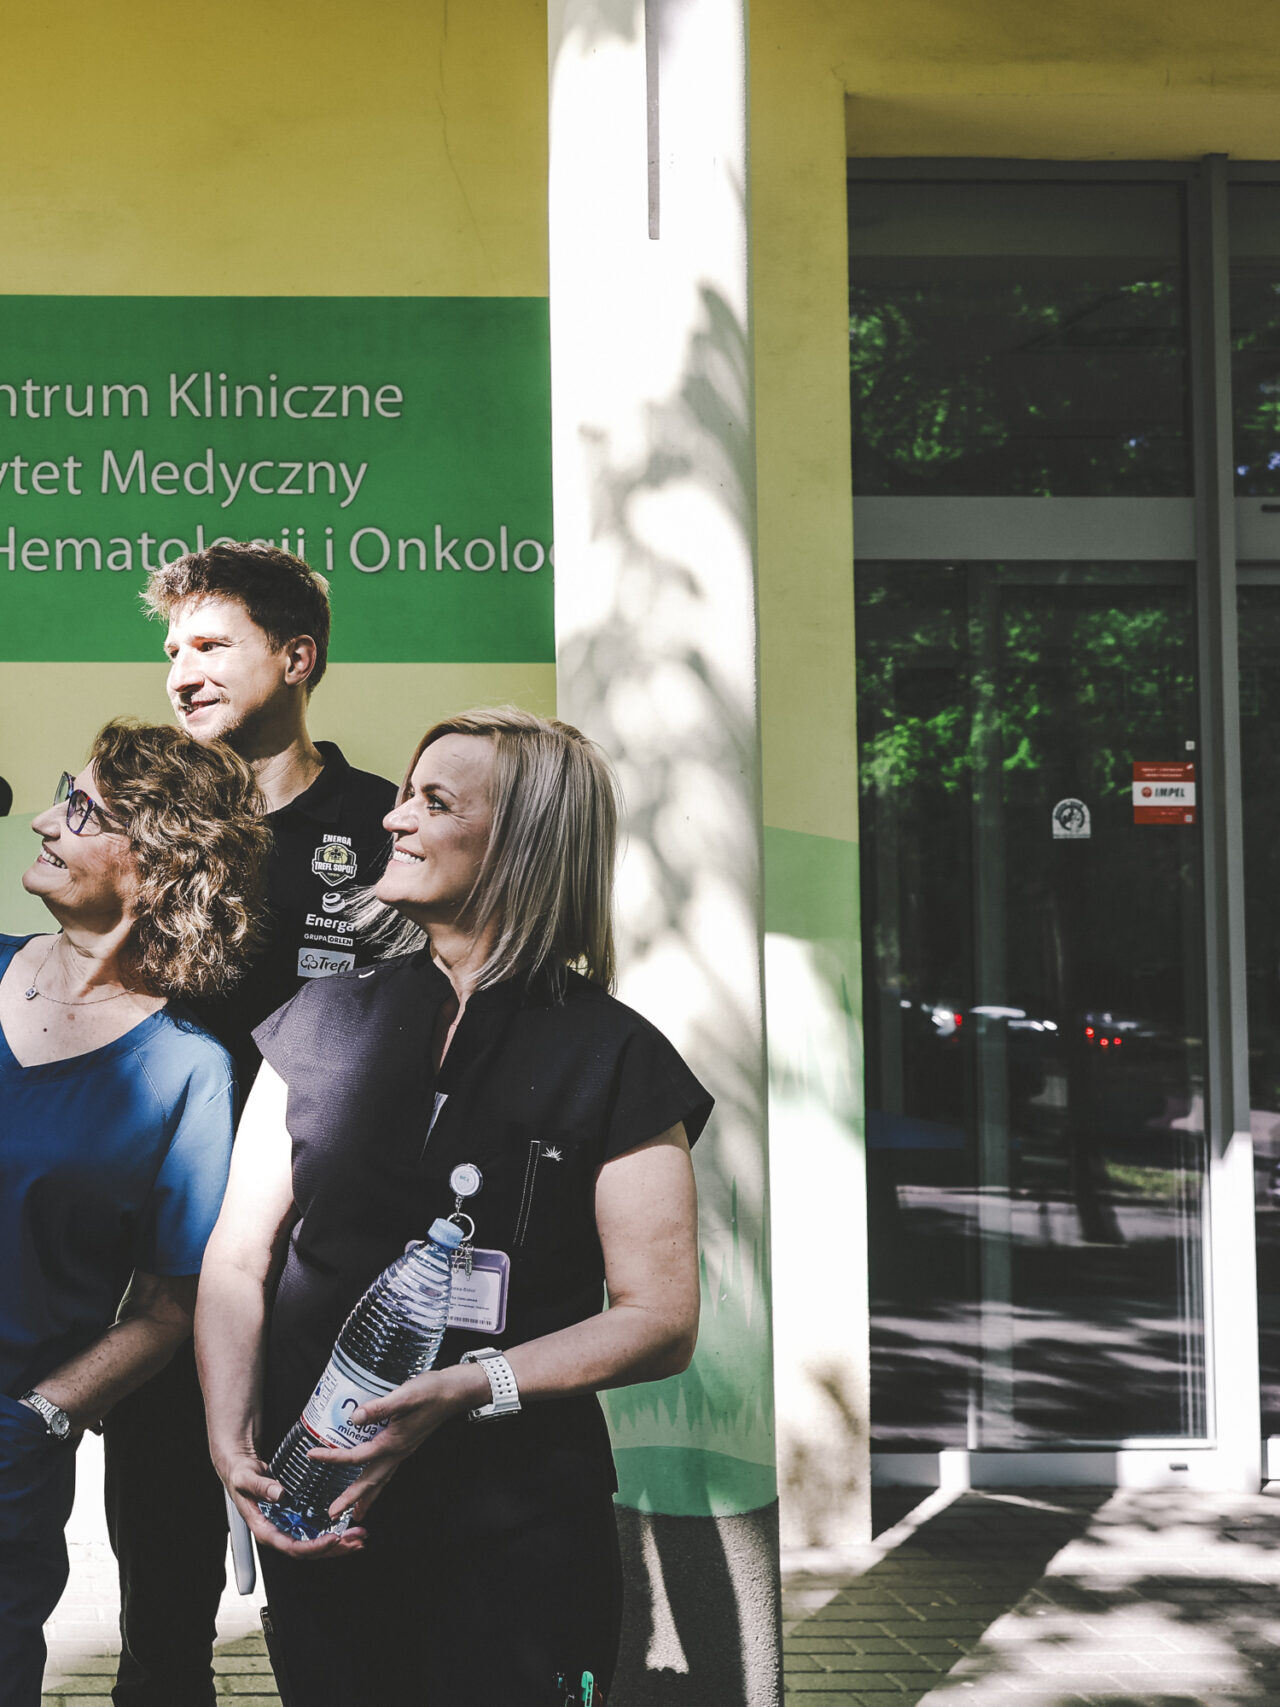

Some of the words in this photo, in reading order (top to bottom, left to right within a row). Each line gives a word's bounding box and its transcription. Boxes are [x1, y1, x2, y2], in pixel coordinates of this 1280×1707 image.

[169, 371, 403, 418] Kliniczne
[100, 448, 368, 509] Medyczny
[324, 527, 334, 571] i
[349, 525, 554, 573] Onkolo
[1154, 787, 1185, 798] IMPEL
[322, 834, 352, 847] ENERGA
[314, 861, 333, 872] TREFL
[333, 863, 355, 875] SOPOT
[305, 913, 355, 933] Energa
[303, 933, 327, 941] GRUPA
[328, 936, 353, 946] ORLEN
[319, 956, 351, 973] Trefl
[337, 1424, 373, 1443] mineral
